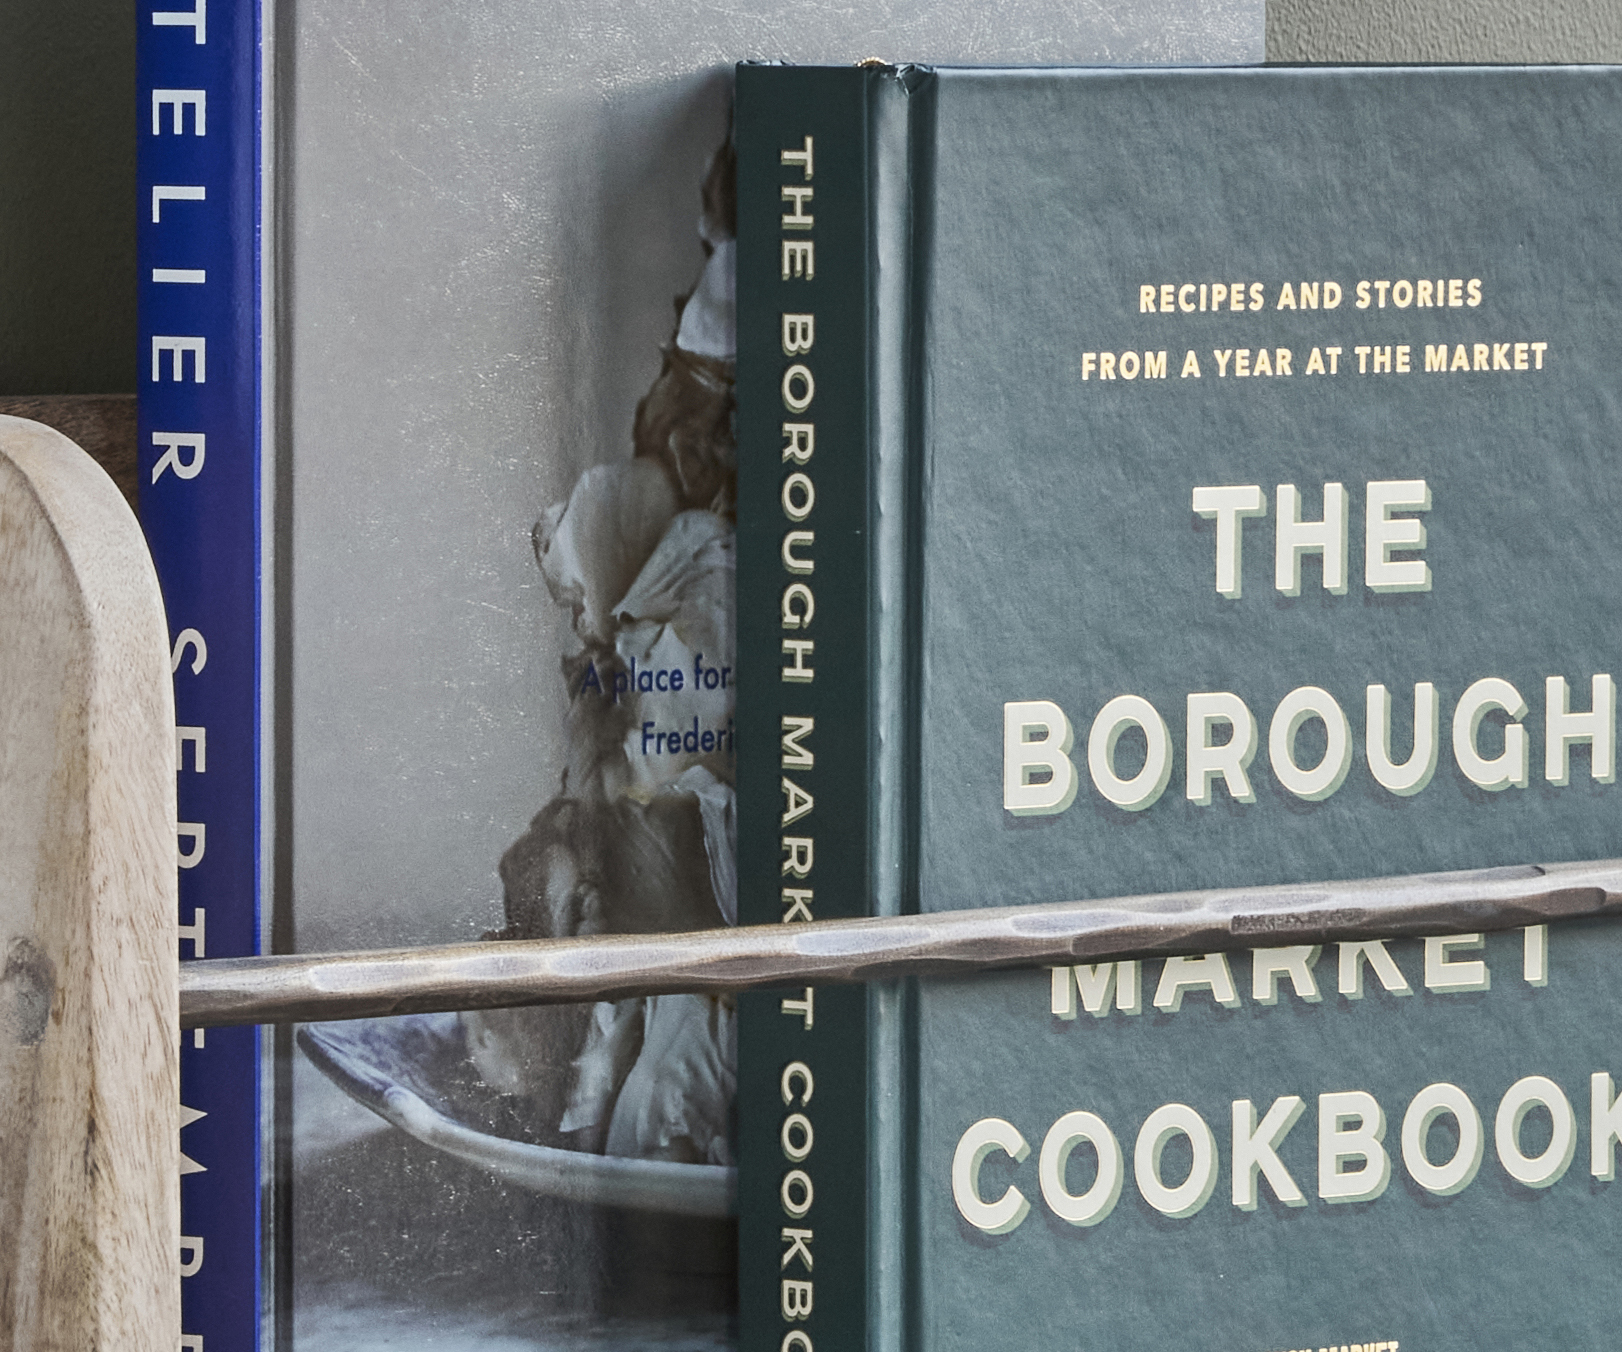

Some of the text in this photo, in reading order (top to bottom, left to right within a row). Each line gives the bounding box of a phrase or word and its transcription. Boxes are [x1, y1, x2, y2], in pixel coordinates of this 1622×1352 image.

[152, 0, 206, 485] TELIER
[780, 137, 815, 280] THE
[1081, 341, 1548, 381] FROM A YEAR AT THE MARKET
[1139, 277, 1484, 314] RECIPES AND STORIES
[780, 314, 815, 684] BOROUGH
[1191, 478, 1433, 599] THE
[581, 652, 732, 704] A place for
[1003, 673, 1616, 819] BOROUGH
[780, 716, 815, 1030] MARKT
